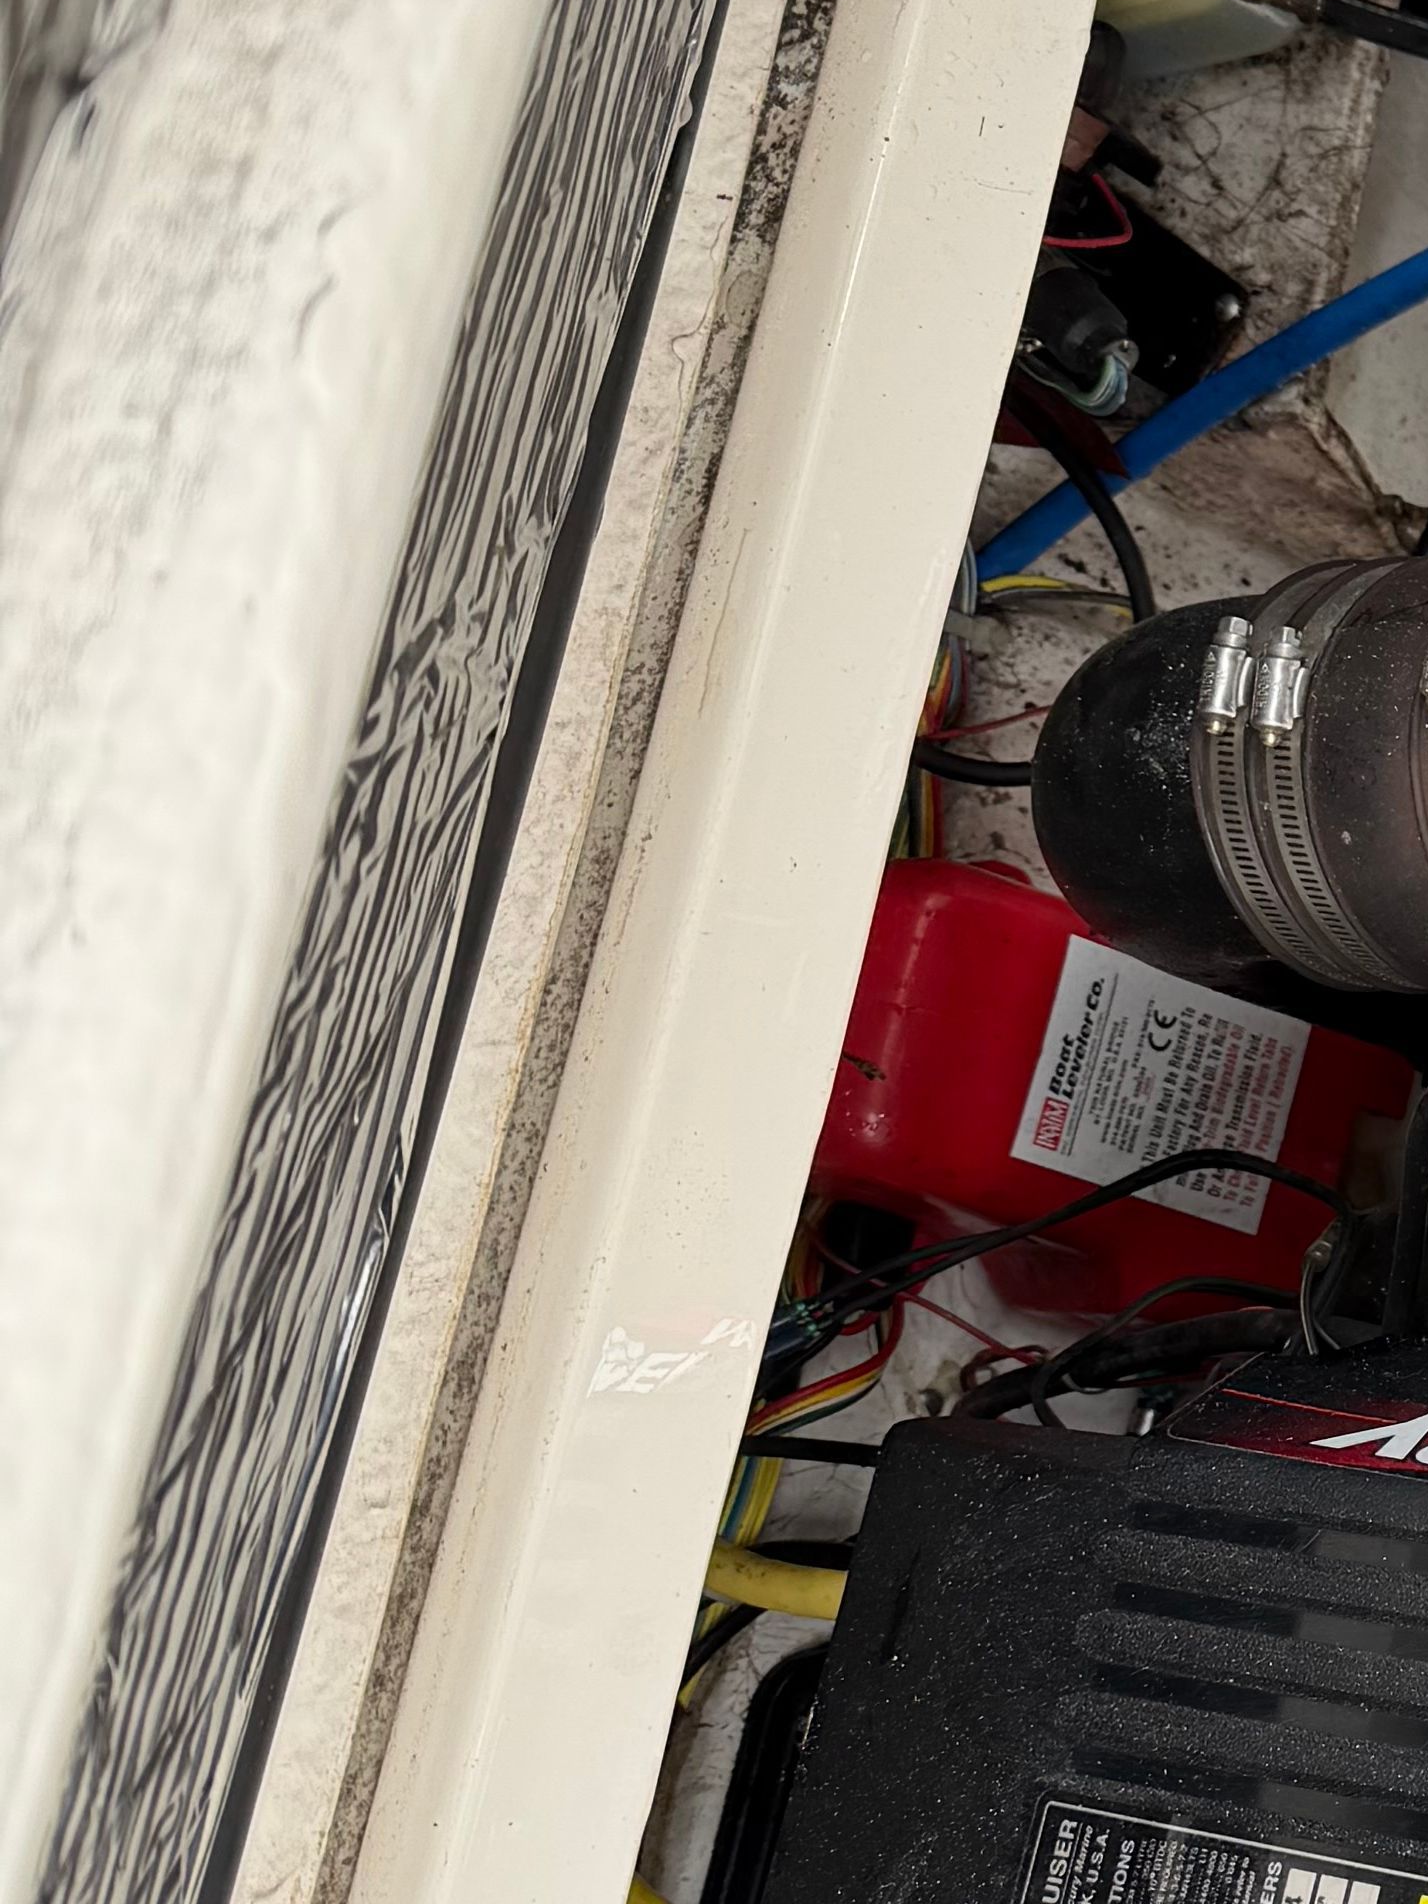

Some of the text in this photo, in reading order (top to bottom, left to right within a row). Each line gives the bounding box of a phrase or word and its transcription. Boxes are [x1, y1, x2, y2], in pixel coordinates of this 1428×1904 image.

[1060, 1010, 1096, 1101] Leveler
[1085, 974, 1106, 1012] Co.
[1207, 1047, 1222, 1061] To
[1046, 1031, 1077, 1095] Boat
[1251, 1061, 1271, 1097] Return
[1141, 1005, 1196, 1163] This Unit Must Be Returned To
[1179, 1073, 1196, 1096] Any
[1194, 1081, 1213, 1111] Drain
[1173, 1095, 1190, 1116] For
[1188, 1111, 1205, 1133] And
[1243, 1097, 1262, 1127] Level
[1207, 1183, 1222, 1197] Or
[1225, 1062, 1254, 1131] Transmission
[1191, 1170, 1206, 1192] Use
[1073, 1824, 1094, 1872] Marine
[1085, 1826, 1111, 1883] U.S.A.
